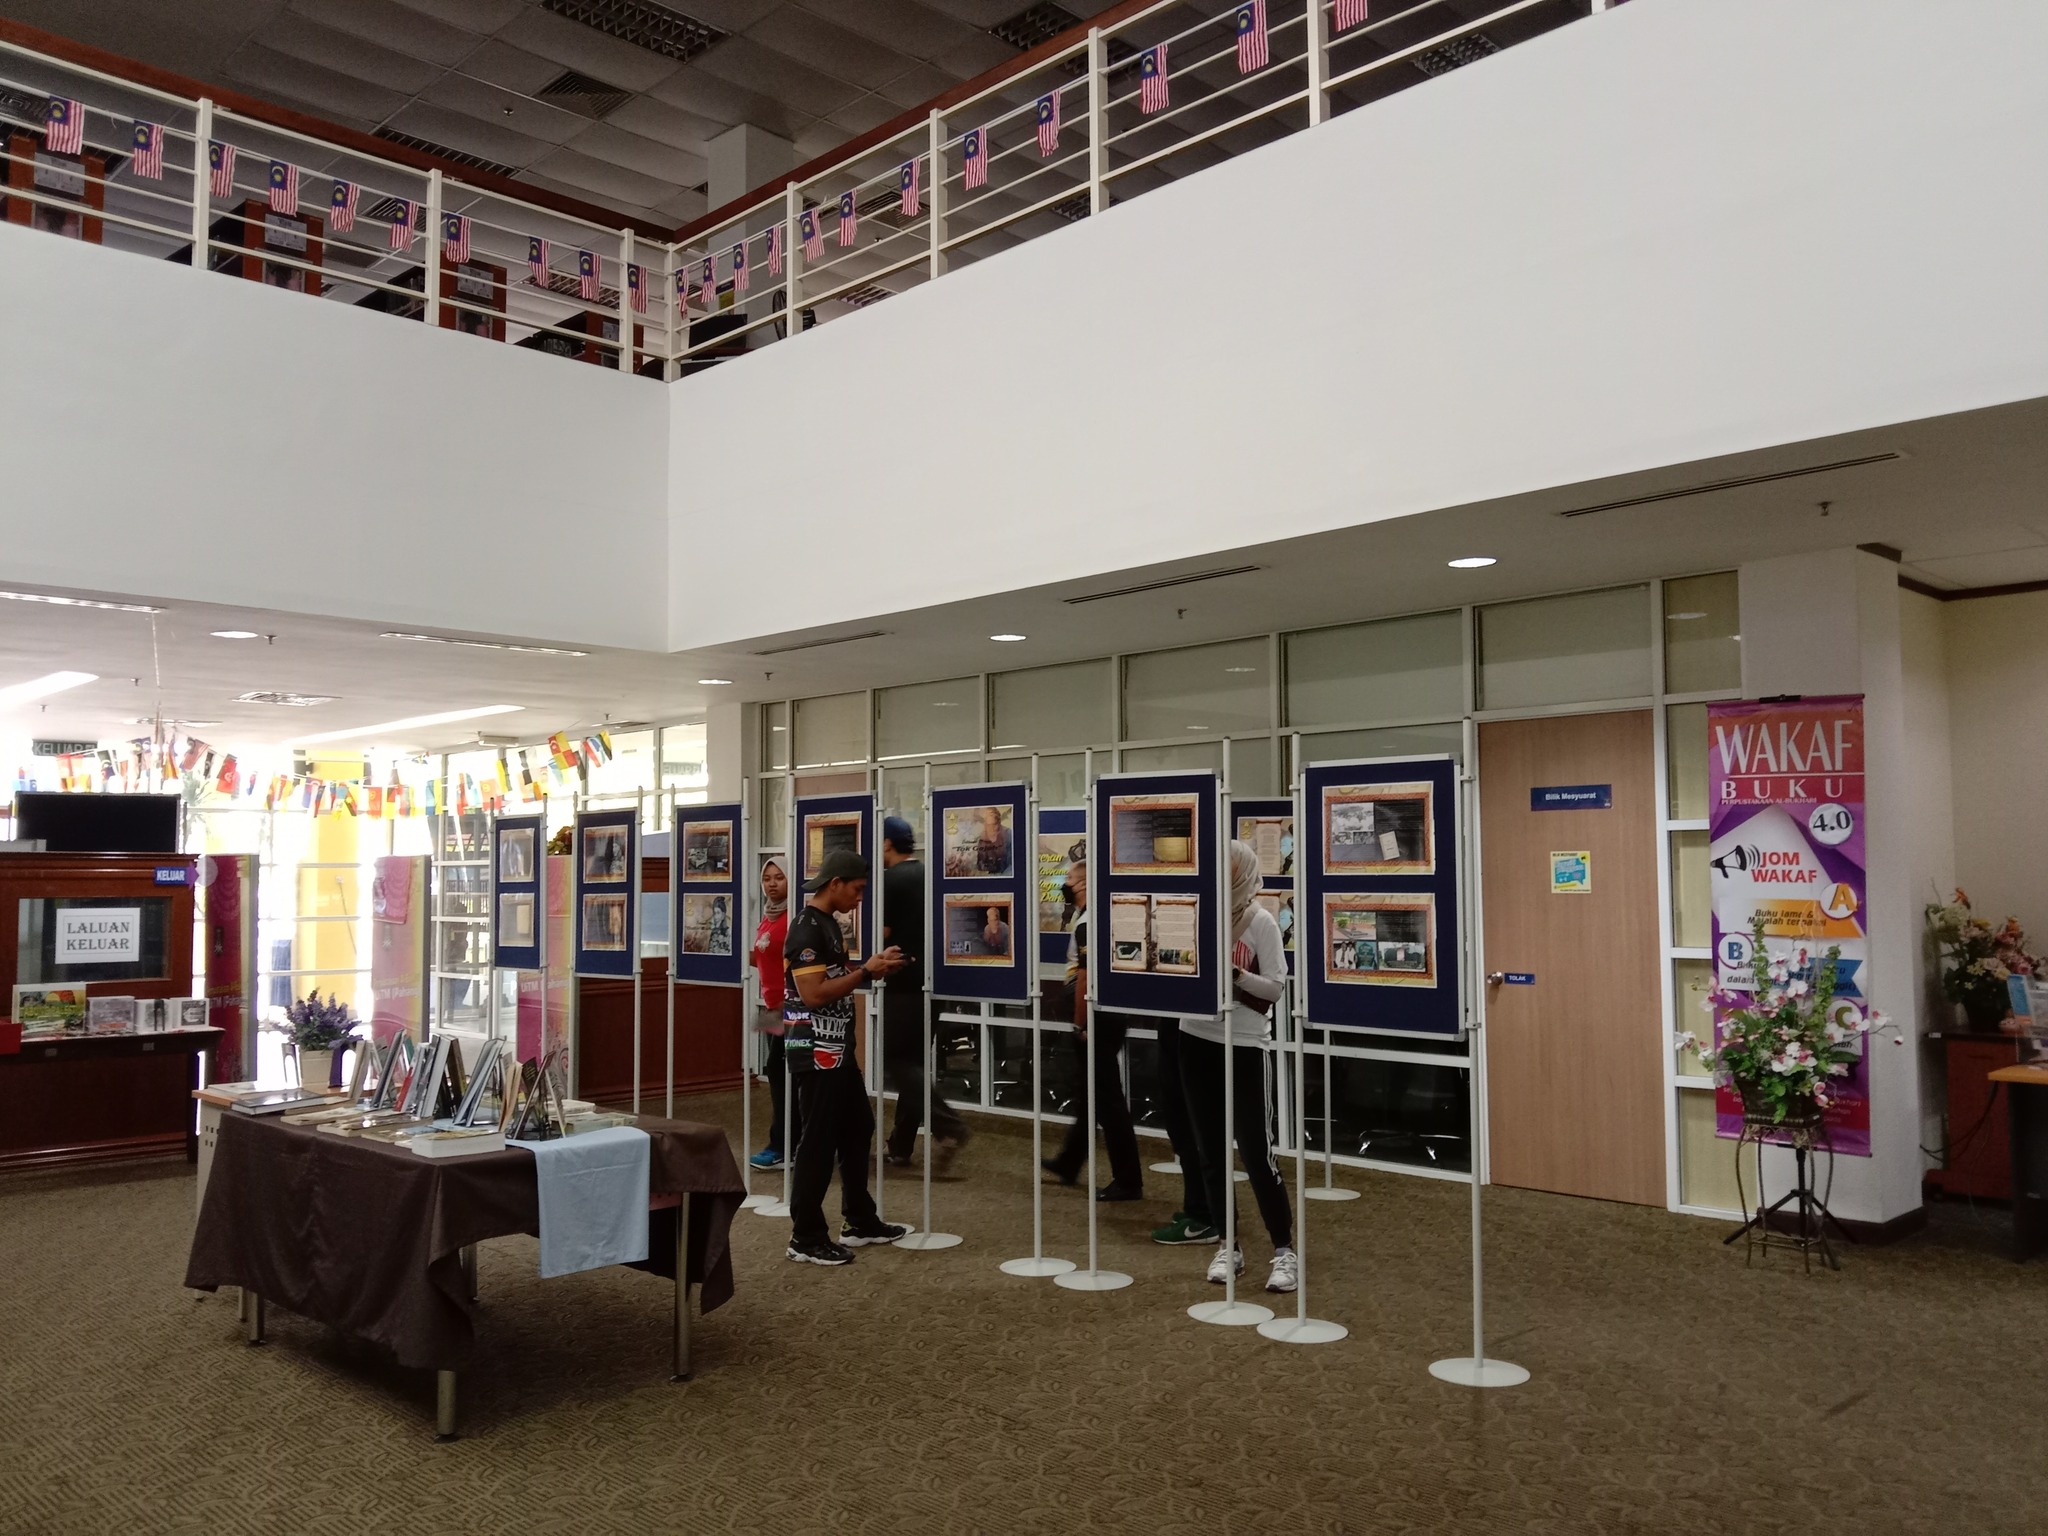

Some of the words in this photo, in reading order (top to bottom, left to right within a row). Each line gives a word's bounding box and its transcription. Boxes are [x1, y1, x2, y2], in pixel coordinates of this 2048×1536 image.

[1715, 720, 1853, 774] WAKAF
[1721, 778, 1843, 799] BUKU
[1561, 792, 1596, 801] Mesyuarat
[1813, 811, 1850, 832] 4.0
[1760, 852, 1800, 867] JOM
[156, 870, 186, 881] KELUAR
[1751, 869, 1817, 883] WAKAF
[1829, 882, 1858, 911] A
[1755, 909, 1778, 917] Buku
[67, 922, 130, 934] LALUAN
[66, 938, 130, 950] KELUAR
[1728, 942, 1743, 960] B
